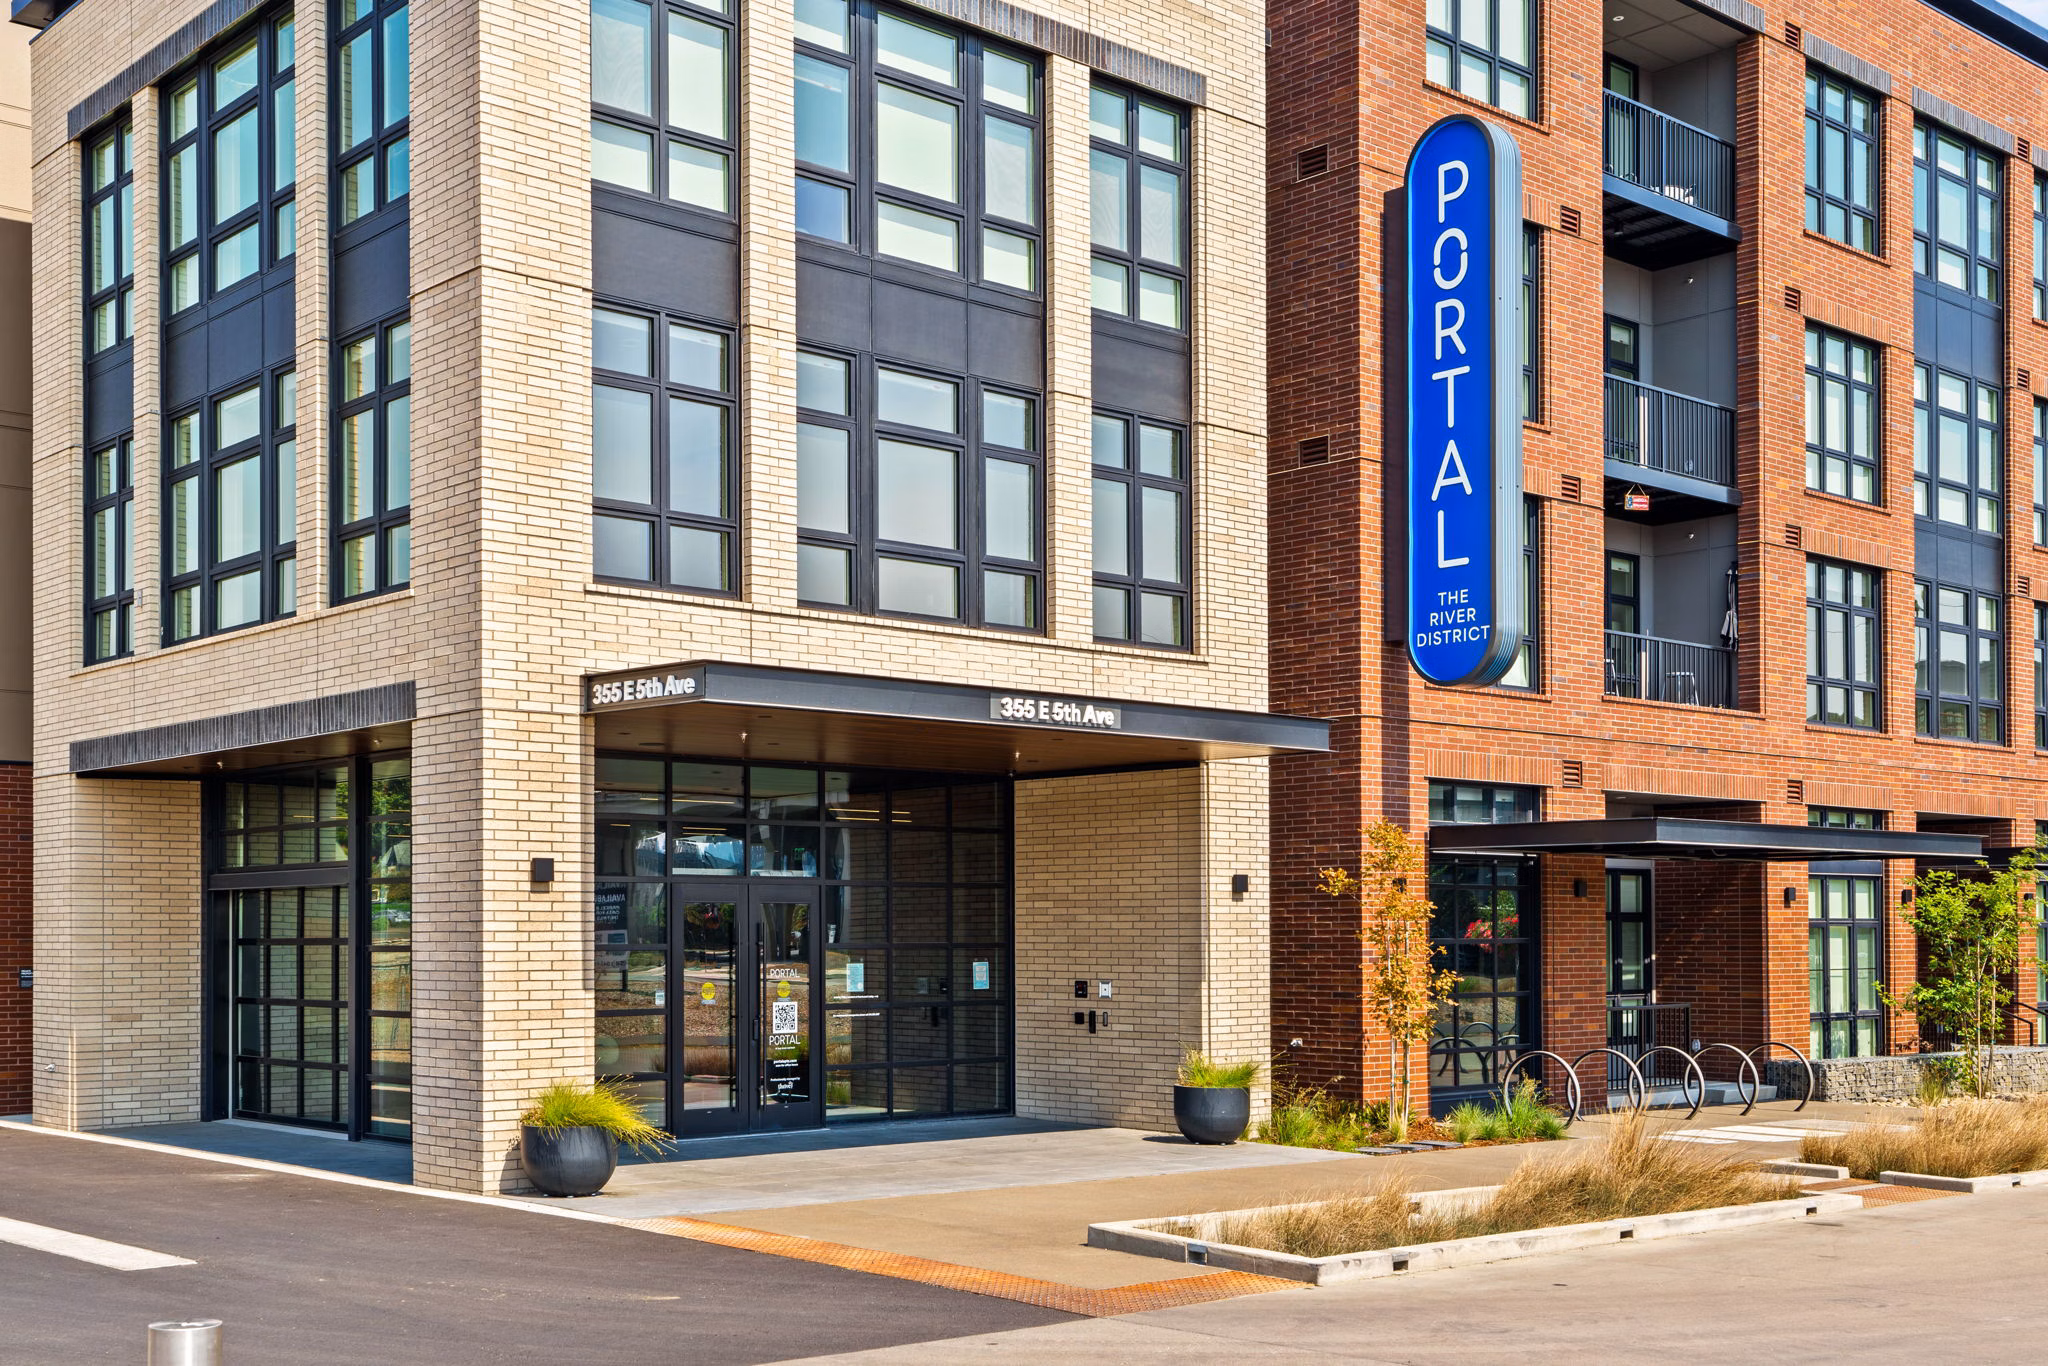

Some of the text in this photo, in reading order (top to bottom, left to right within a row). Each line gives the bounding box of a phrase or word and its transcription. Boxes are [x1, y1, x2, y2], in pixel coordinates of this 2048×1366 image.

[1431, 159, 1473, 569] PORTAL
[1437, 588, 1469, 606] THE
[1430, 607, 1476, 627] RIVER
[1416, 625, 1491, 648] DISTRICT
[592, 675, 696, 705] 355 E 5th Ave
[1000, 697, 1115, 726] 355 E 5th Ave
[770, 968, 801, 978] PORTAL
[769, 1034, 801, 1046] PORTAL
